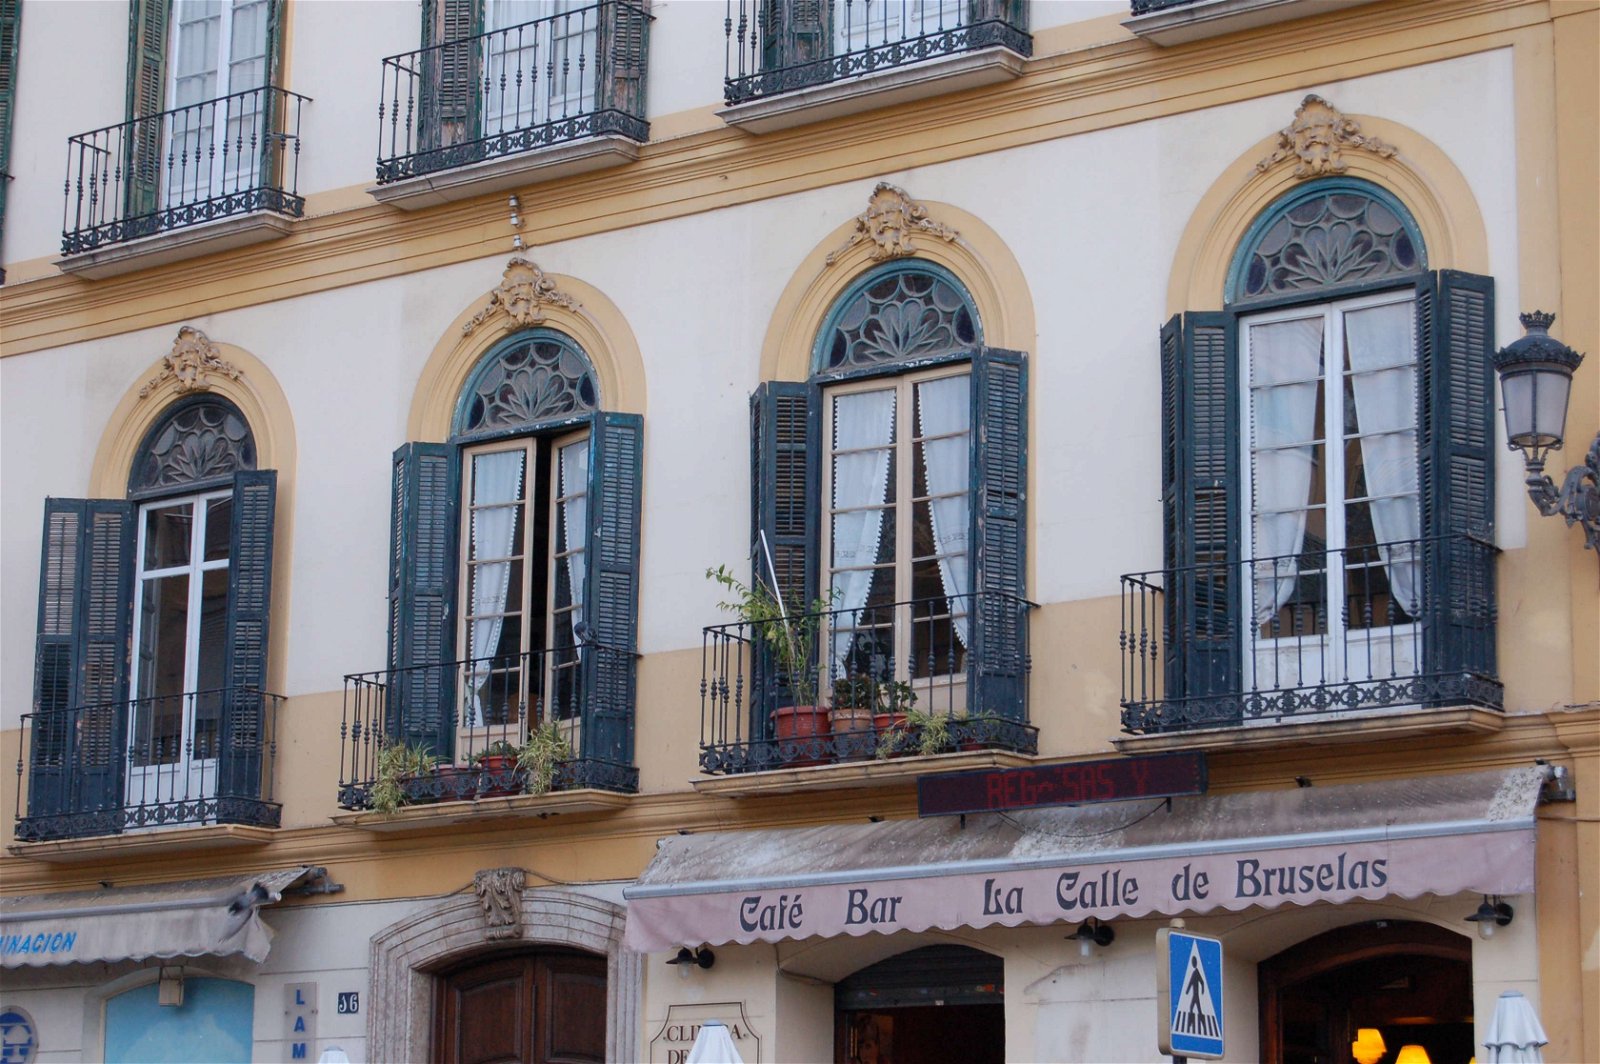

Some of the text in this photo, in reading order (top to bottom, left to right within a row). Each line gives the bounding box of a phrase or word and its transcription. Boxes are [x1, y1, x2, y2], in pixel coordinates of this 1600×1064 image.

[739, 852, 1388, 932] Café Bar La Calle de Bruselas
[666, 1023, 742, 1042] CLIA
